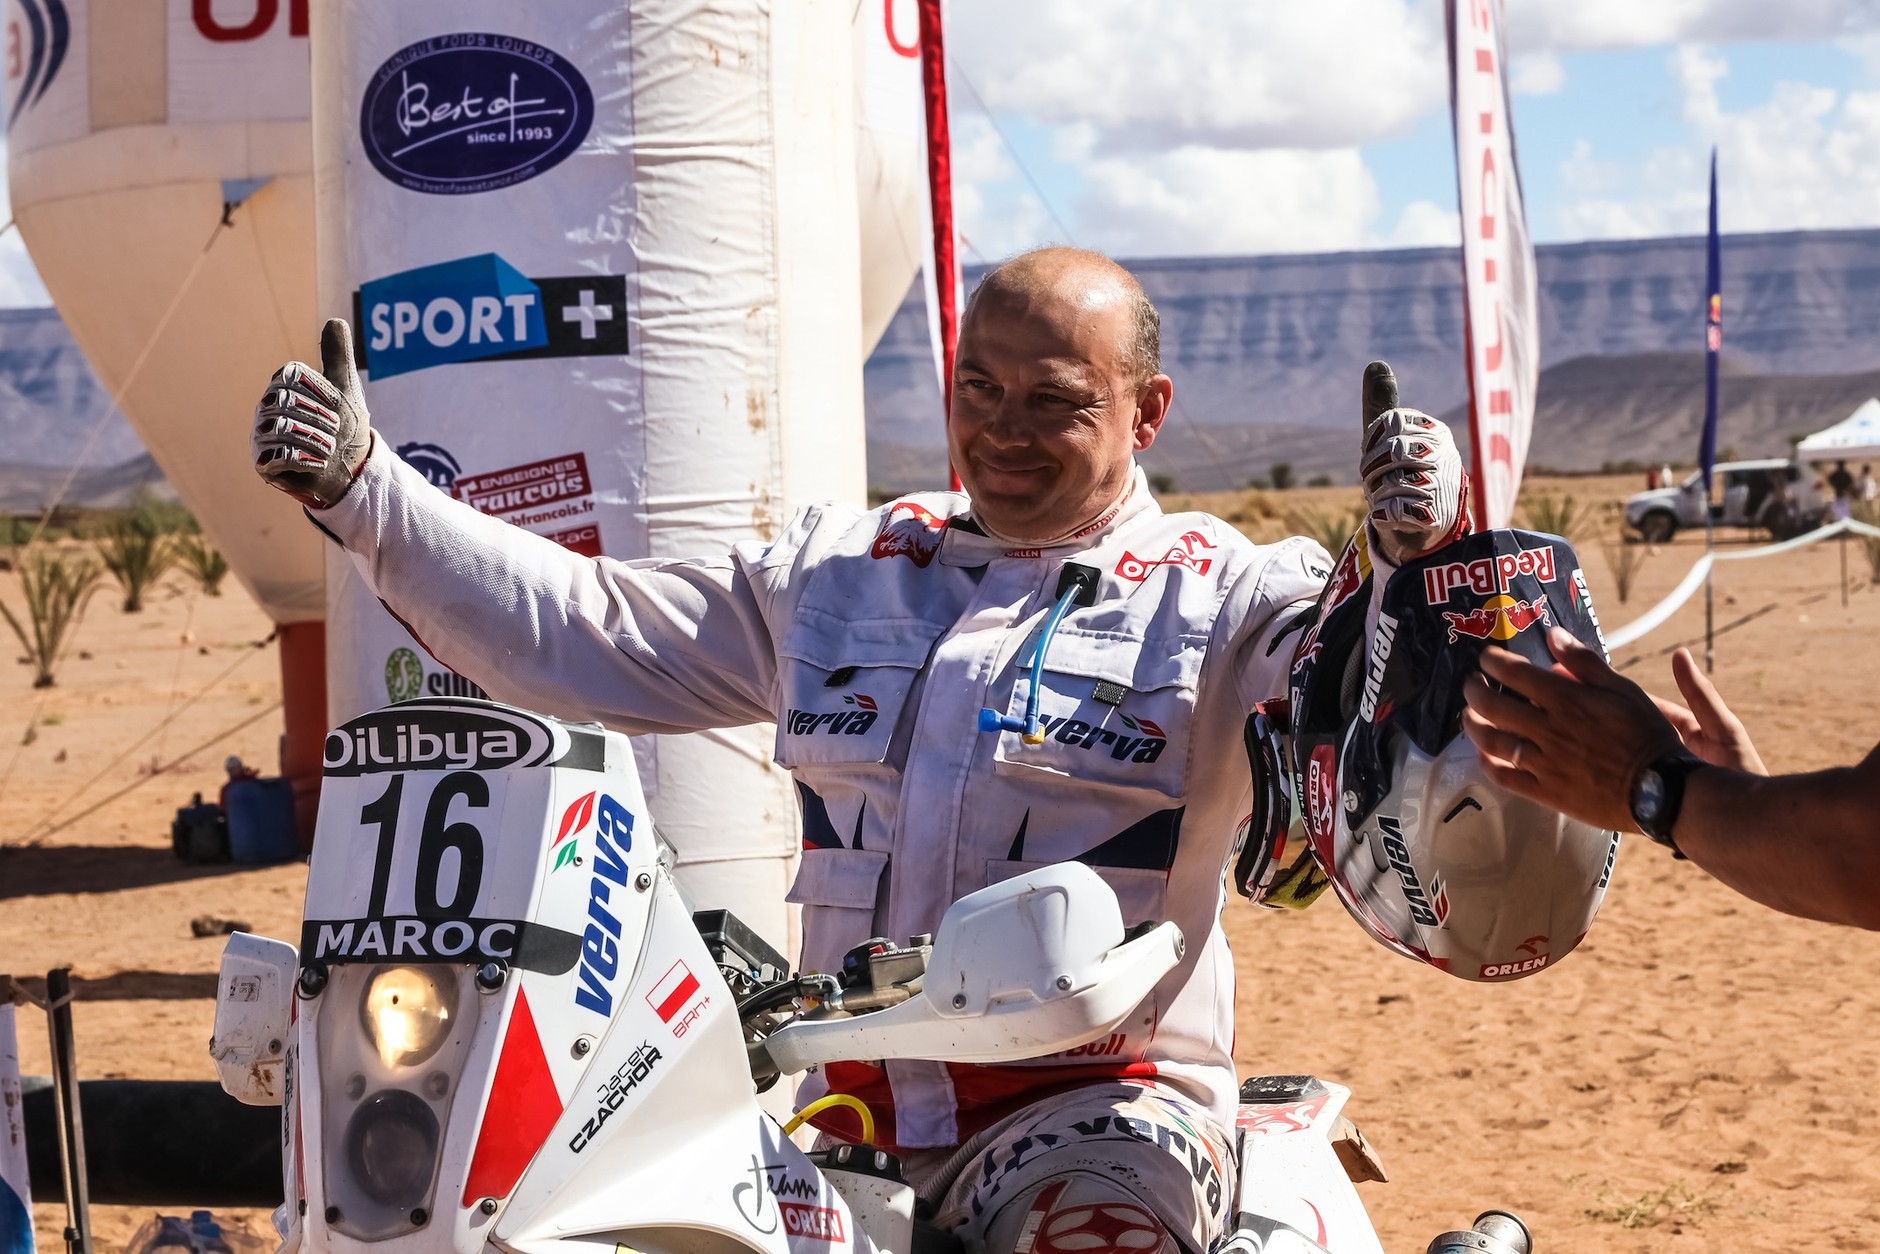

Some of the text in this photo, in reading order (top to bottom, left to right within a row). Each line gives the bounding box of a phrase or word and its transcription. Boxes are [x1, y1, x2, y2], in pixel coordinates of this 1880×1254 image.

[379, 34, 554, 80] CLINIQUE POIDS LOURDS
[467, 127, 553, 144] since 1993
[371, 293, 535, 351] SPORT
[480, 459, 577, 490] ENSEIGNES
[1360, 610, 1399, 723] verva
[787, 709, 878, 735] verva
[1039, 714, 1167, 763] verva
[323, 723, 518, 769] OiLibya
[1310, 768, 1321, 833] ORLEN
[360, 771, 490, 919] 16
[1376, 813, 1439, 928] verva
[575, 793, 635, 1018] verva
[315, 920, 517, 958] MAROC
[1483, 956, 1548, 977] ORLEN
[569, 1047, 663, 1153] CZACHOR
[785, 1207, 842, 1239] ORLEN
